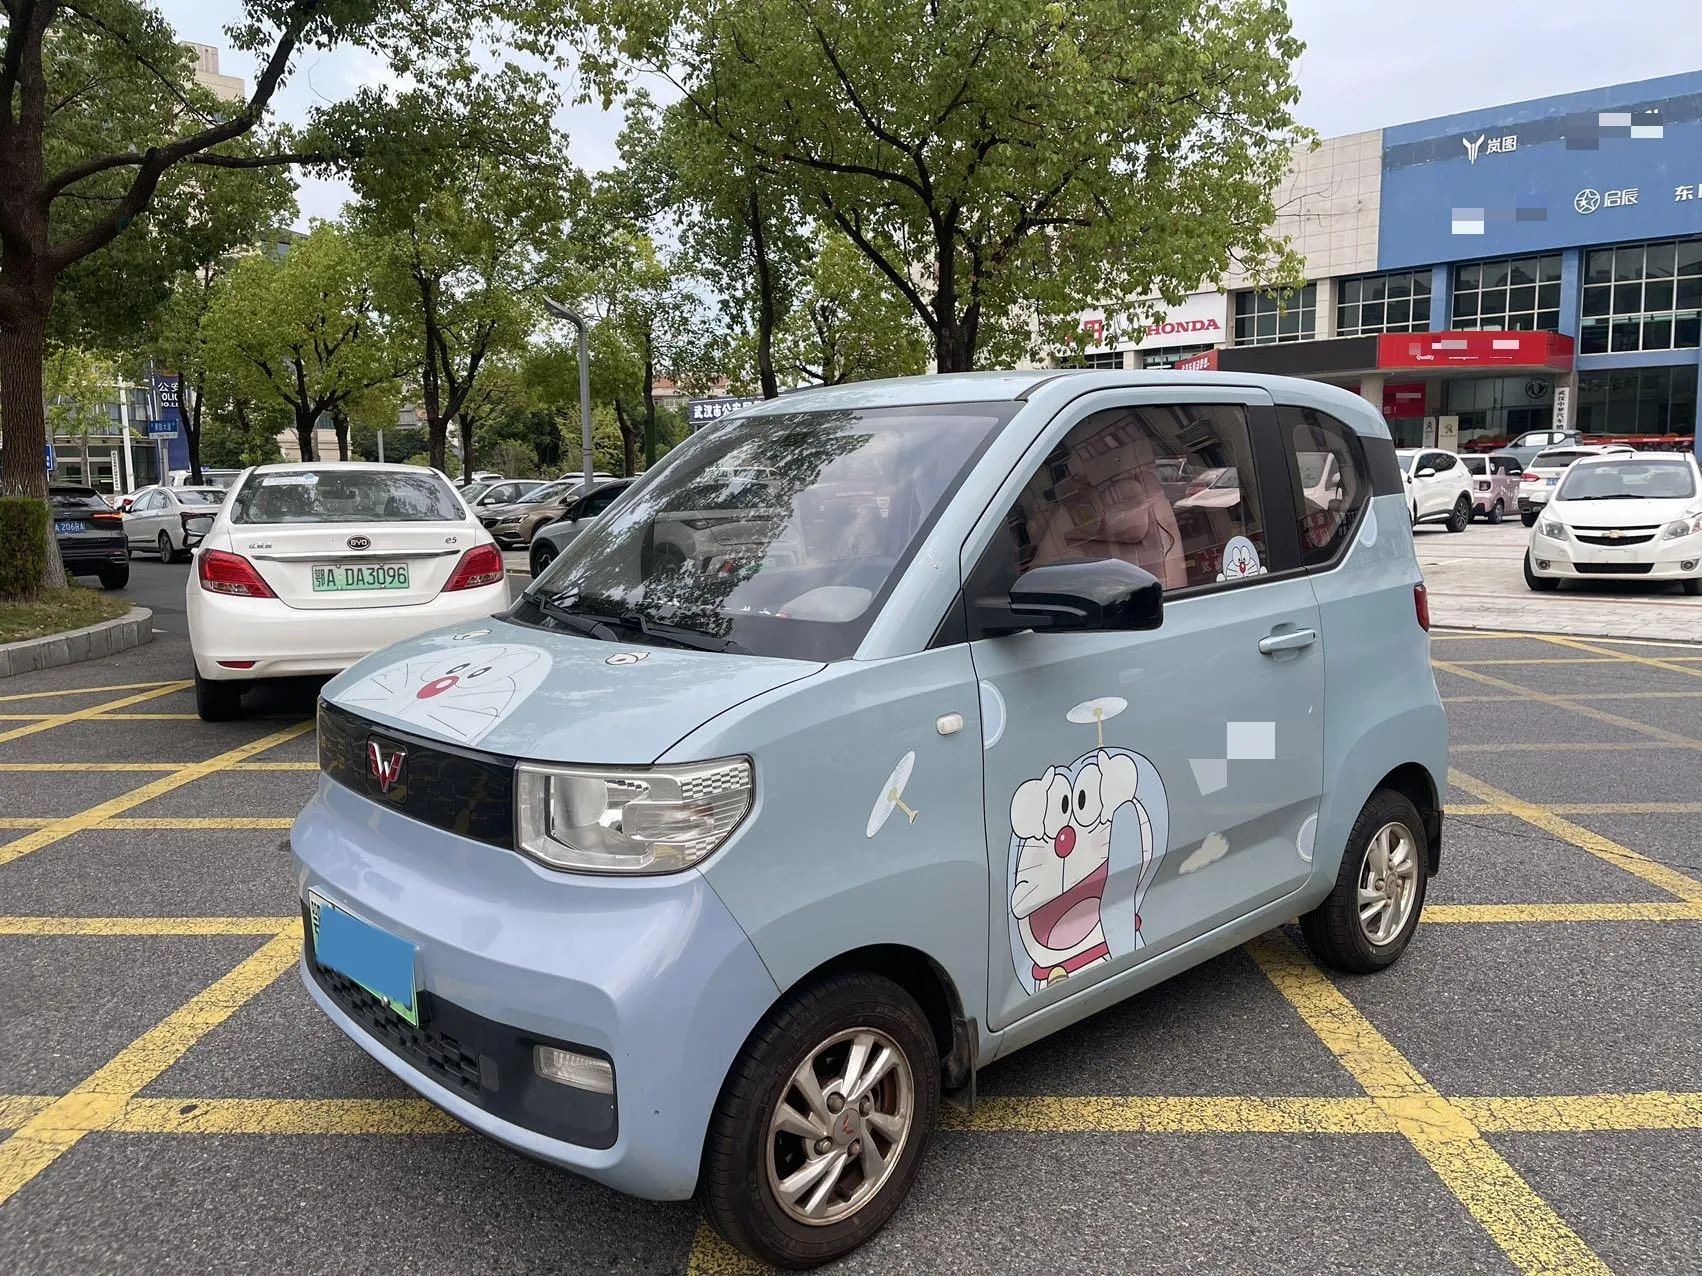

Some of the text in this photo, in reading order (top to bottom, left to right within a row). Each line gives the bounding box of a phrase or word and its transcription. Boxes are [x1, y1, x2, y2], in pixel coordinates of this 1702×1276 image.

[1486, 135, 1518, 155] 岚图
[1604, 187, 1639, 208] 启辰
[1146, 319, 1221, 336] HONDA
[445, 536, 457, 544] e5
[344, 566, 407, 587] DA3096
